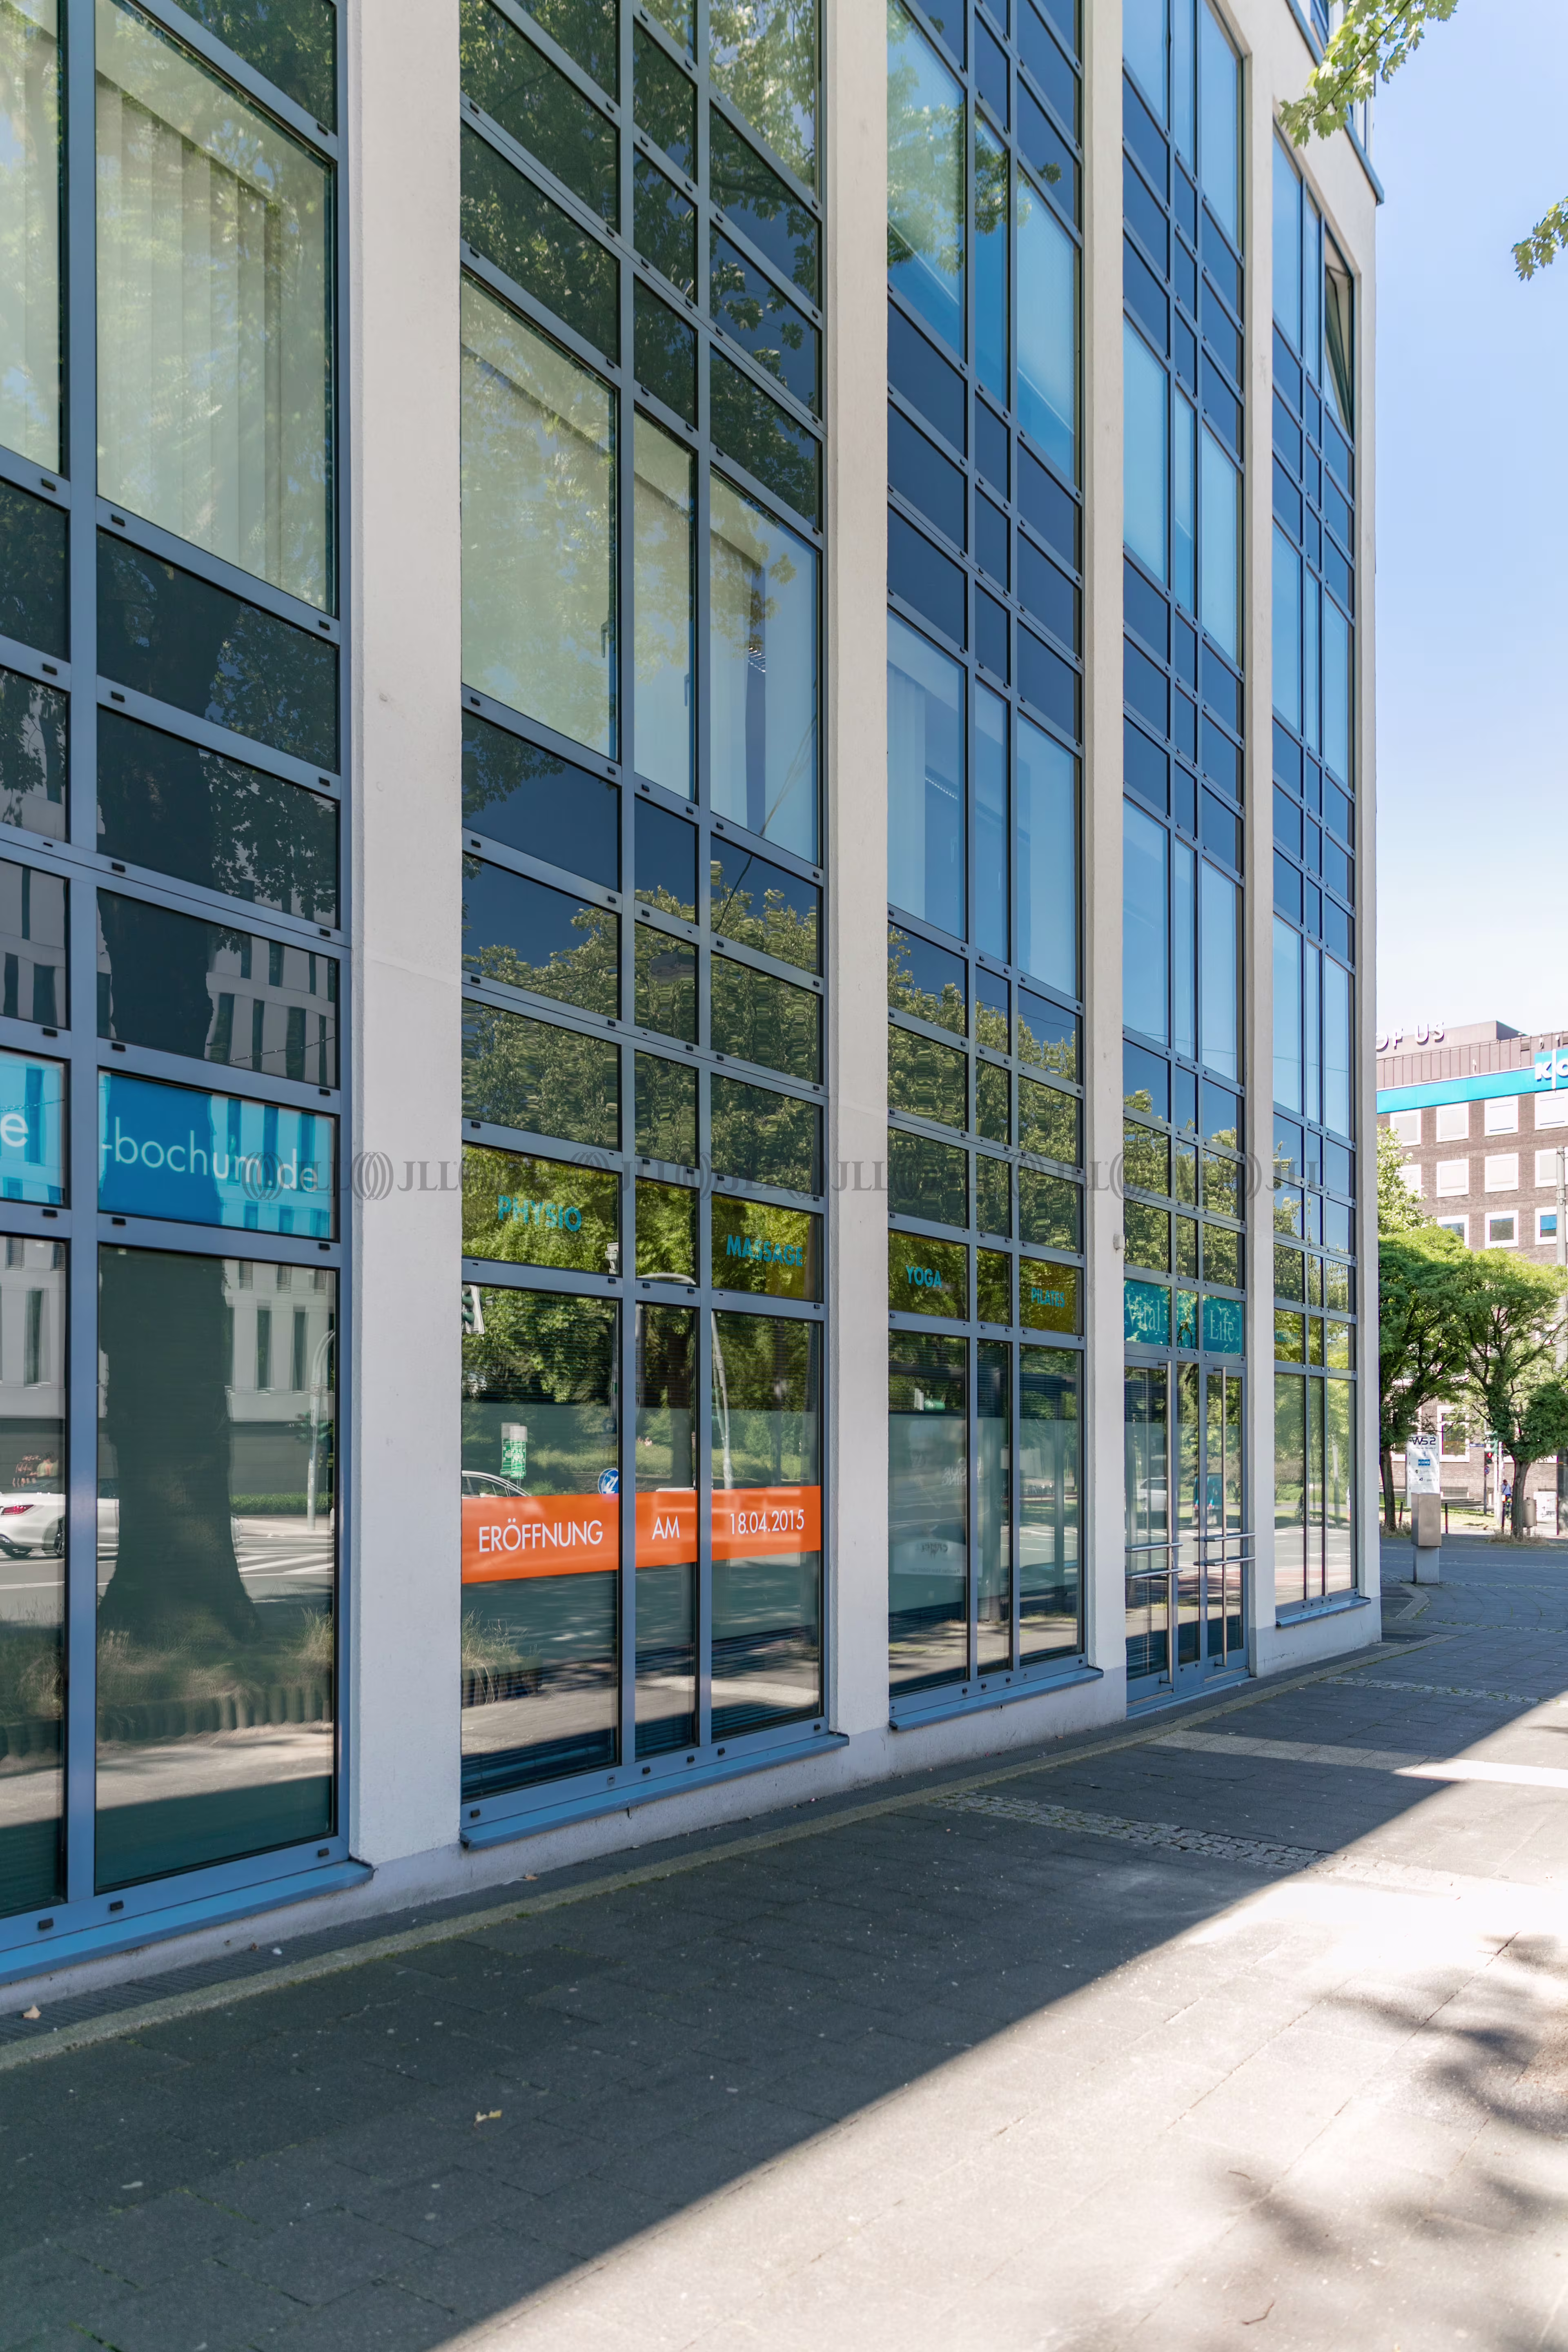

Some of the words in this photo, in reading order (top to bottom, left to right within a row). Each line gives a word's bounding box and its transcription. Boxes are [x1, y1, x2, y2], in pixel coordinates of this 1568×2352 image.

[497, 1195, 582, 1232] PHYSIO
[726, 1234, 803, 1267] MASSAGE
[906, 1265, 942, 1288] YOGA
[1031, 1287, 1065, 1308] PILATES
[1126, 1294, 1161, 1332] Vital
[1209, 1310, 1235, 1343] Life
[479, 1517, 604, 1552] ERÖFFNUNG
[652, 1515, 680, 1540] AM
[729, 1508, 804, 1535] 18.04.2015
